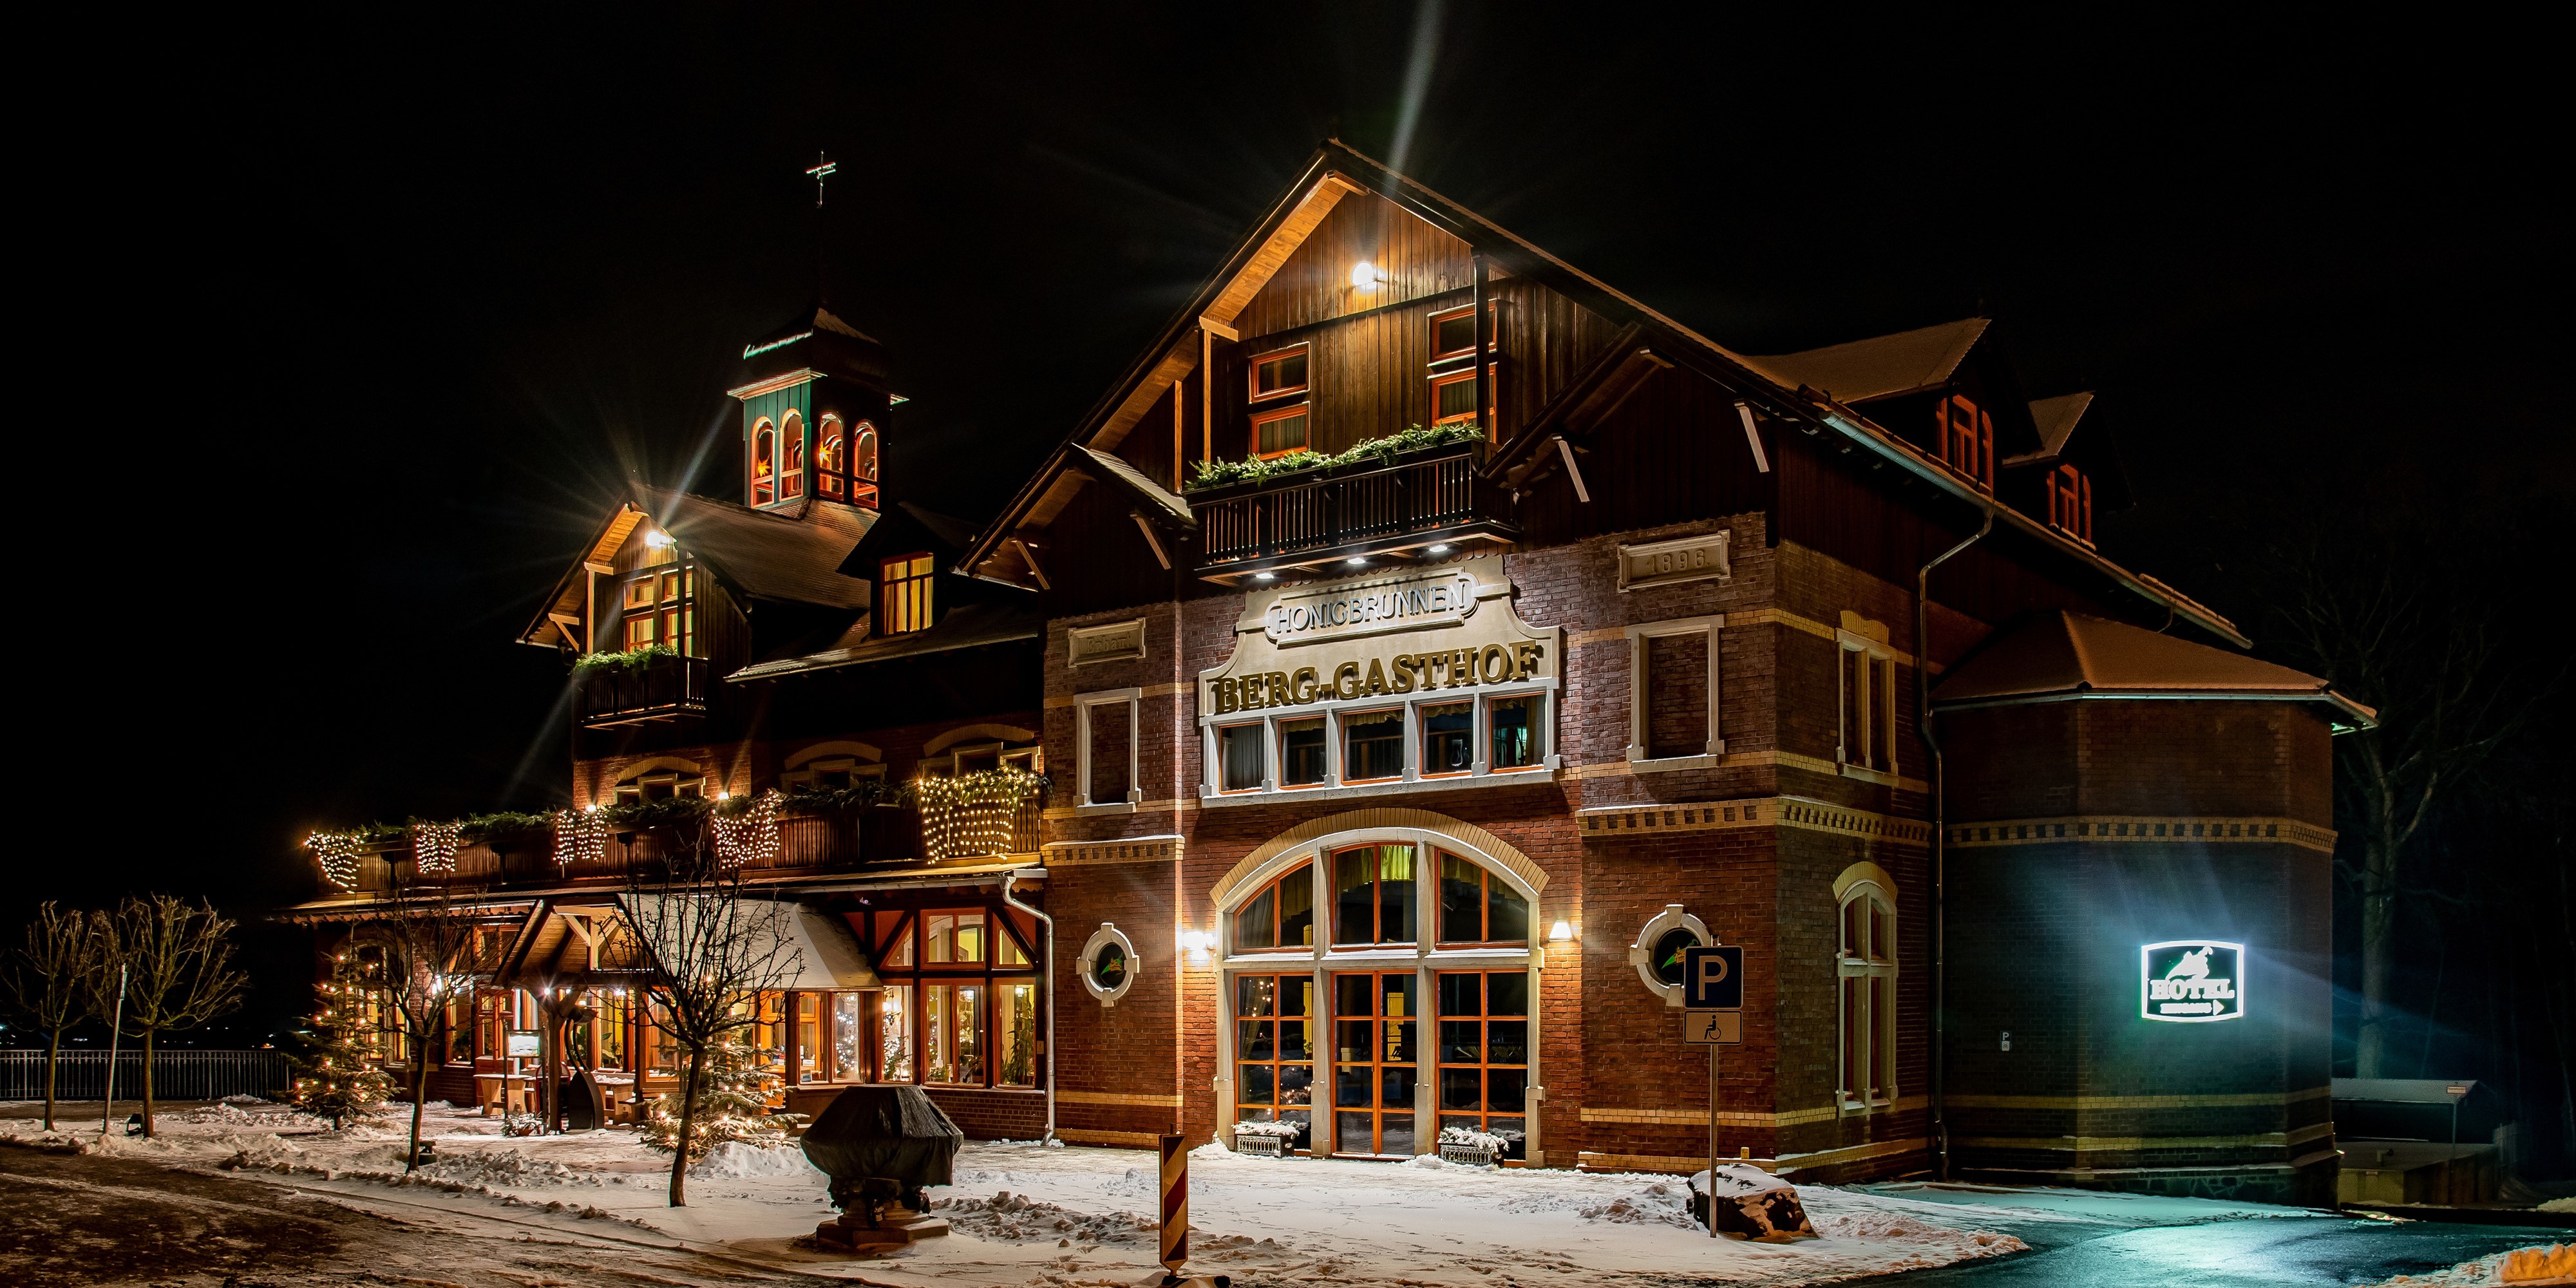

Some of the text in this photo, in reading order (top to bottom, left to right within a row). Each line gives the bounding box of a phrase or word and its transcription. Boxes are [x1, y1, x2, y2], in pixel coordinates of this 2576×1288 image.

[1277, 583, 1465, 633] HONIGBRUNNEN
[1213, 640, 1537, 715] BERG-GASTHOF
[1698, 955, 1728, 1000] P
[2150, 978, 2235, 999] HOTEL
[2002, 1032, 2009, 1041] P
